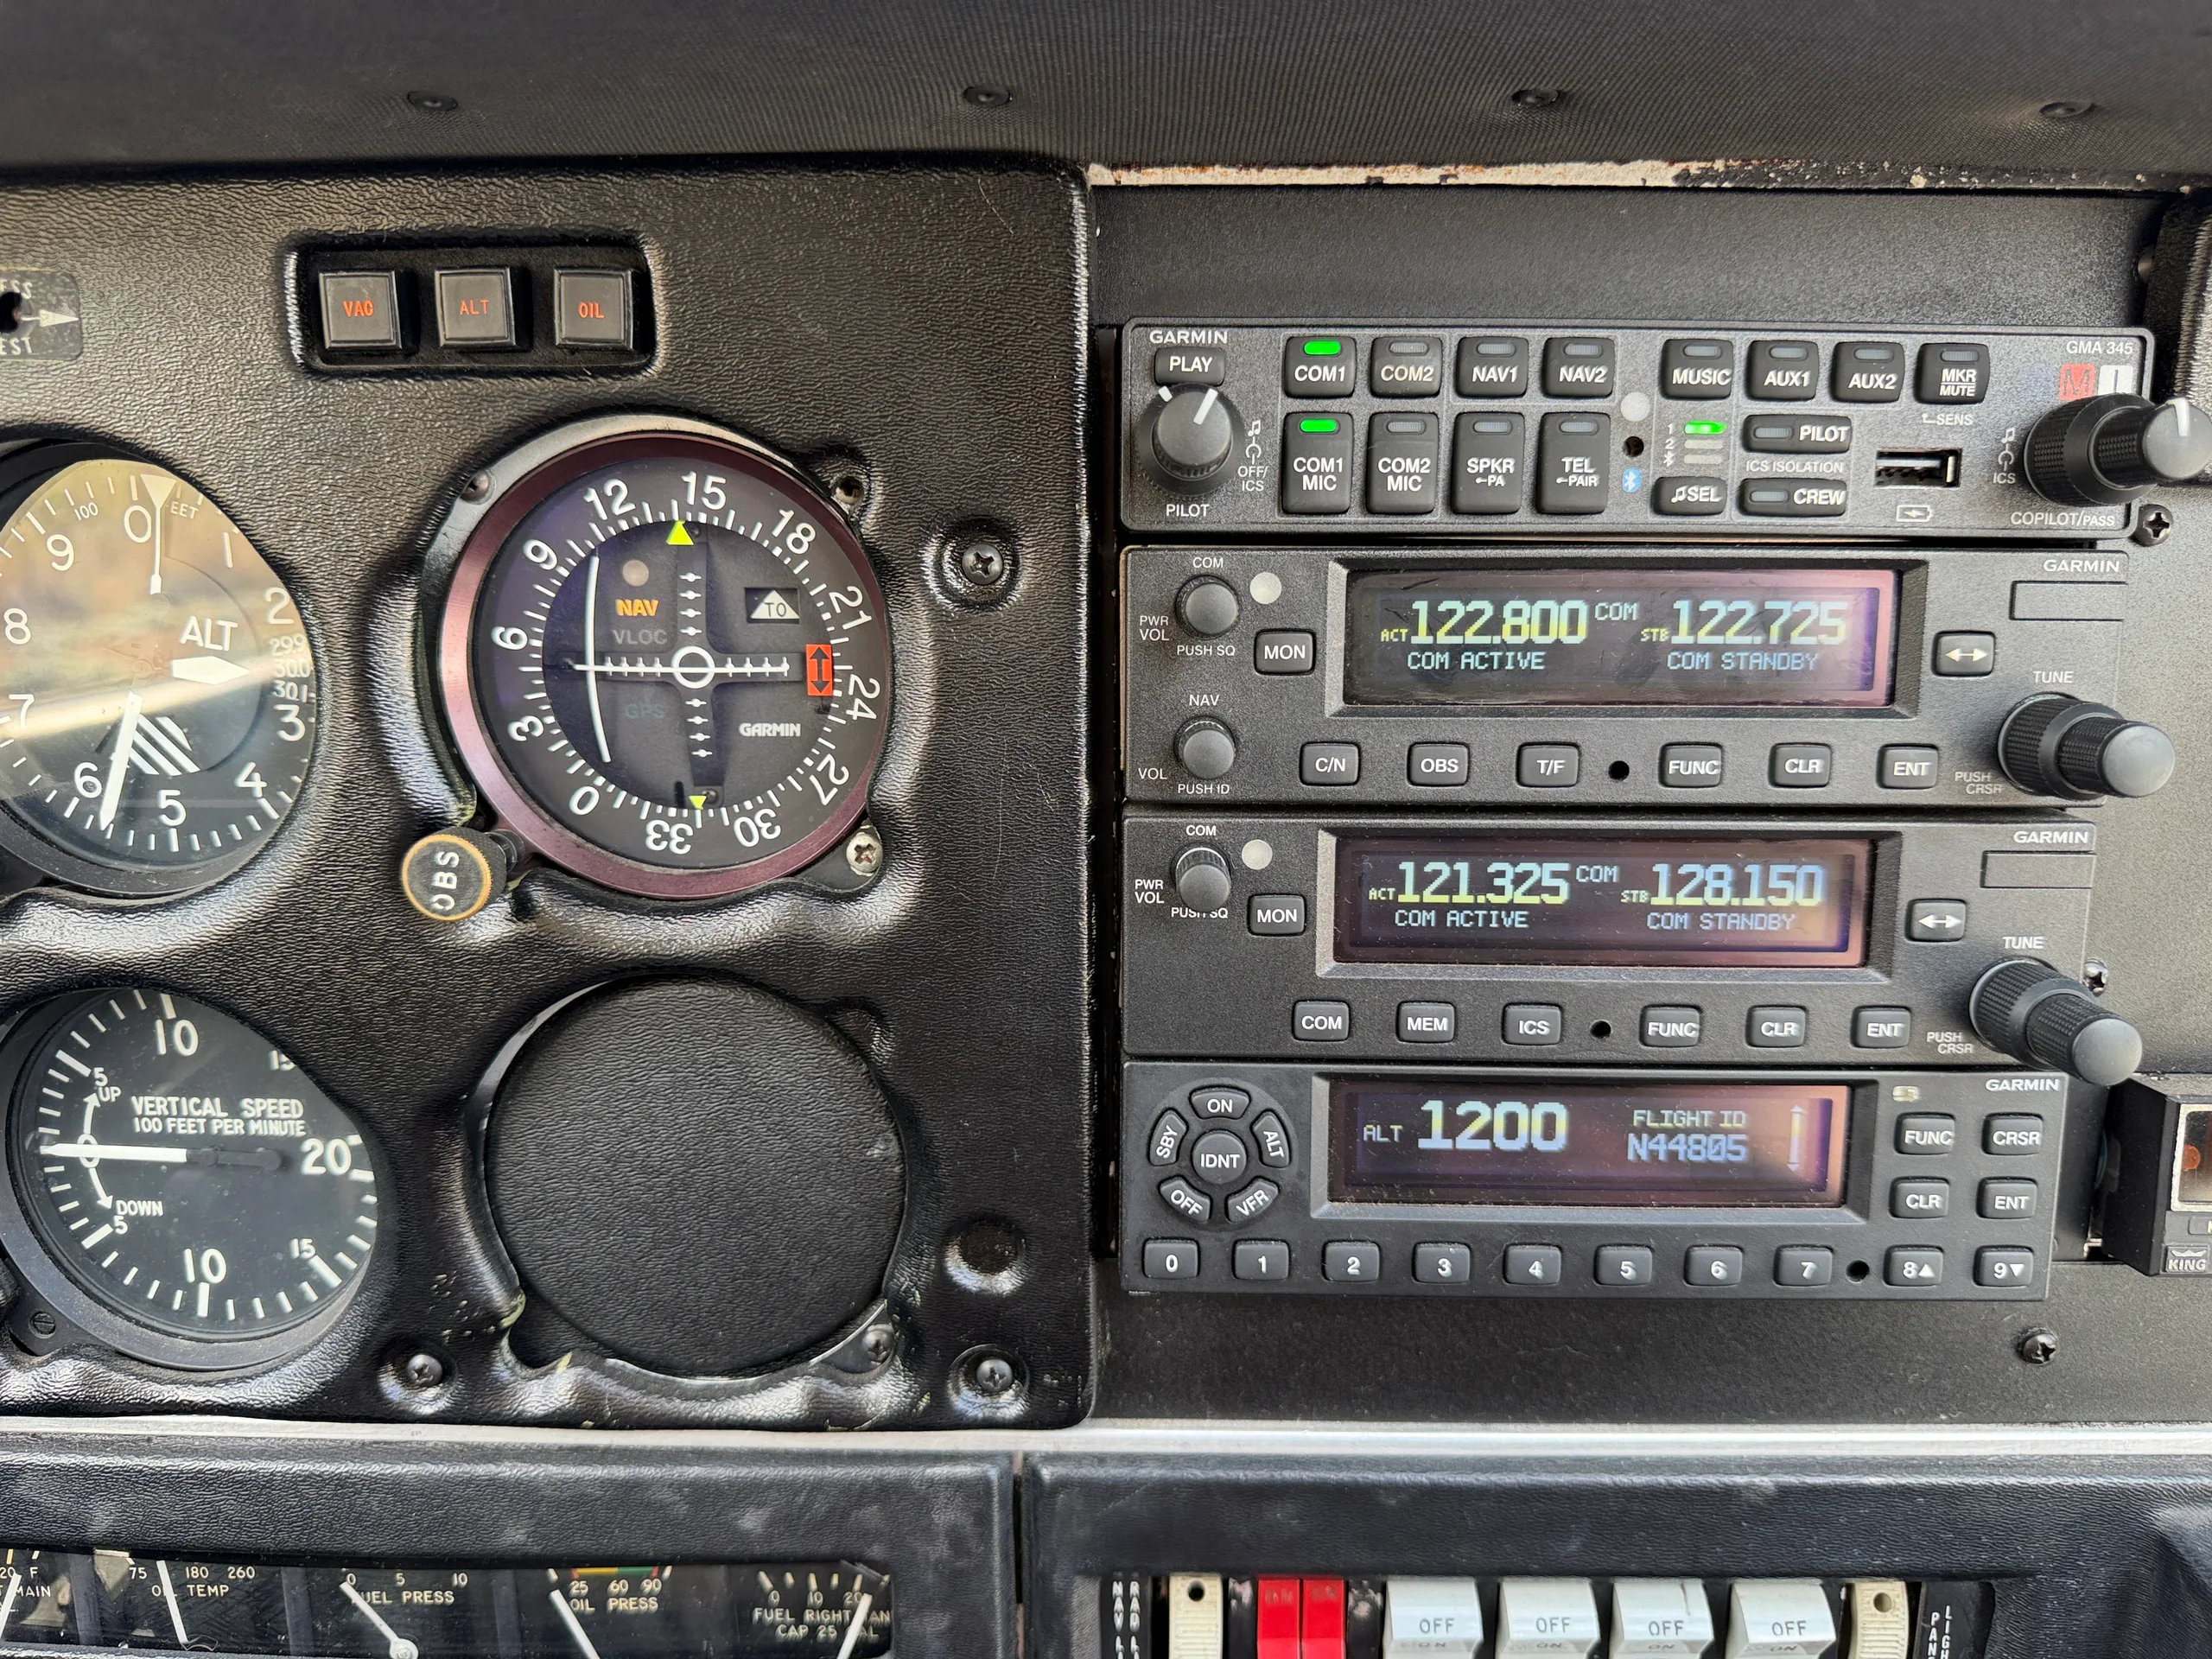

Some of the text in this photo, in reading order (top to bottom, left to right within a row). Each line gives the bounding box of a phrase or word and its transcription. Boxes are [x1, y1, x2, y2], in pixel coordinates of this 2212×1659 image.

[459, 300, 489, 316] ALT
[577, 302, 605, 319] OIL
[1149, 330, 1228, 344] GARMIN
[2066, 340, 2133, 355] GMA 345
[1169, 356, 1212, 372] PLAY
[1294, 365, 1345, 382] COM1
[1381, 365, 1434, 382] COM2
[1472, 365, 1518, 383] NAV1
[1559, 365, 1608, 384] NAV2
[1672, 367, 1732, 385] MUSIC
[1764, 370, 1811, 387] AUX1
[1849, 372, 1897, 390] AUX2
[1942, 368, 1977, 383] MKR
[1940, 385, 1976, 397] MUTE
[1936, 414, 1974, 426] SENS
[1800, 425, 1850, 442] PILOT
[1237, 466, 1268, 479] OFF/
[1294, 457, 1344, 474] COM1
[1377, 457, 1431, 474] COM2
[1466, 458, 1515, 474] SPKR
[1561, 456, 1595, 474] TEL
[1746, 461, 1844, 474] ICS ISOLATION
[1242, 480, 1264, 492] ICS
[1302, 474, 1337, 491] MIC
[1387, 474, 1422, 492] MIC
[1993, 473, 2016, 484] ICS
[681, 471, 727, 511] 15
[1687, 487, 1721, 502] SEL
[1793, 488, 1847, 505] CREW
[583, 478, 637, 521] 12
[1166, 504, 1210, 517] PILOT
[2011, 512, 2114, 527] COPILOT/PASS
[771, 508, 816, 555] 18
[1192, 557, 1224, 569] COM
[2043, 559, 2120, 573] GARMIN
[264, 587, 295, 625] 2
[615, 599, 659, 618] NAV
[763, 602, 788, 618] TO
[829, 585, 873, 631] 21
[1139, 616, 1169, 626] PWR
[1380, 600, 1638, 645] ACT 122.800 COM
[1640, 600, 1848, 645] STB 122.725
[179, 615, 238, 652] ALT
[612, 629, 668, 645] VLOC
[1139, 629, 1170, 641] VOL
[1177, 645, 1236, 657] PUSH SQ
[1263, 645, 1306, 659] MON
[1407, 651, 1547, 670] COM ACTIVE
[1667, 652, 1819, 671] COM STANDBY
[2033, 671, 2074, 683] TUNE
[847, 677, 881, 721] 24
[1189, 695, 1219, 706] NAV
[625, 702, 667, 719] GPS
[273, 704, 306, 741] 3
[739, 722, 802, 737] GARMIN
[1138, 768, 1168, 779] VOL
[1314, 758, 1346, 773] C/N
[1421, 758, 1459, 773] OBS
[1536, 759, 1566, 776] T/F
[1668, 760, 1721, 776] FUNC
[1784, 759, 1823, 774] CLR
[1892, 761, 1930, 777] ENT
[234, 762, 268, 798] 4
[1955, 772, 1992, 783] PUSH
[1178, 784, 1230, 794] PUSH ID
[1966, 783, 2003, 795] CRSR
[157, 790, 188, 826] 5
[1185, 825, 1217, 836] COM
[2013, 830, 2088, 844] GARMIN
[431, 850, 461, 912] OBS
[1135, 879, 1164, 890] PWR
[1369, 861, 1620, 905] ACT 121.325 COM
[1620, 863, 1825, 906] STB 128.150
[1135, 892, 1165, 904] VOL
[1256, 909, 1297, 923] MON
[1395, 909, 1530, 929] COM ACTIVE
[1647, 912, 1797, 931] COM STANDBY
[2002, 936, 2045, 950] TUNE
[1301, 1015, 1342, 1030] COM
[1407, 1016, 1449, 1032] MEM
[1518, 1020, 1550, 1035] ICS
[1648, 1022, 1700, 1037] FUNC
[1760, 1021, 1799, 1037] CLR
[1867, 1022, 1905, 1037] ENT
[155, 1019, 199, 1057] 10
[1926, 1032, 1962, 1043] PUSH
[1937, 1043, 1974, 1054] CRSR
[1986, 1078, 2060, 1092] GARMIN
[98, 1086, 122, 1103] UP
[130, 1096, 304, 1119] VERTICAL SPEED
[1207, 1098, 1233, 1114] ON
[131, 1116, 307, 1137] 100 FEET PER MINUTE
[1363, 1100, 1569, 1152] ALT 1200
[1633, 1109, 1747, 1128] FLIGHT ID
[1156, 1124, 1179, 1160] SBY
[1262, 1129, 1285, 1160] ALT
[1904, 1130, 1954, 1146] FUNC
[1993, 1130, 2041, 1146] CRSR
[1626, 1133, 1749, 1162] N44805
[300, 1138, 352, 1175] 20
[1200, 1154, 1241, 1168] IDNT
[115, 1199, 164, 1217] DOWN
[1170, 1189, 1203, 1217] OFF
[1236, 1189, 1270, 1218] VFR
[1905, 1193, 1942, 1209] CLR
[1994, 1195, 2030, 1210] ENT
[113, 1216, 129, 1234] 5
[289, 1237, 316, 1260] 15
[183, 1248, 228, 1285] 10
[1346, 1256, 1362, 1275] 2
[1619, 1260, 1637, 1280] 5
[1801, 1261, 1817, 1280] 7
[2168, 1258, 2207, 1271] KING
[130, 1567, 147, 1580] 75
[185, 1567, 209, 1580] 180
[227, 1566, 256, 1580] 260
[452, 1573, 468, 1588] 10
[187, 1585, 229, 1597] TEMP
[569, 1580, 589, 1597] 25
[607, 1579, 630, 1597] 60
[640, 1579, 663, 1597] 90
[402, 1591, 454, 1605] PRESS
[569, 1598, 595, 1613] OIL
[607, 1597, 658, 1613] PRESS
[753, 1607, 851, 1626] FUEL RIGHT
[775, 1624, 838, 1642] CAP 25
[1420, 1618, 1455, 1634] OFF
[1535, 1617, 1571, 1633] OFF
[1648, 1620, 1684, 1636] OFF
[1771, 1620, 1807, 1636] OFF
